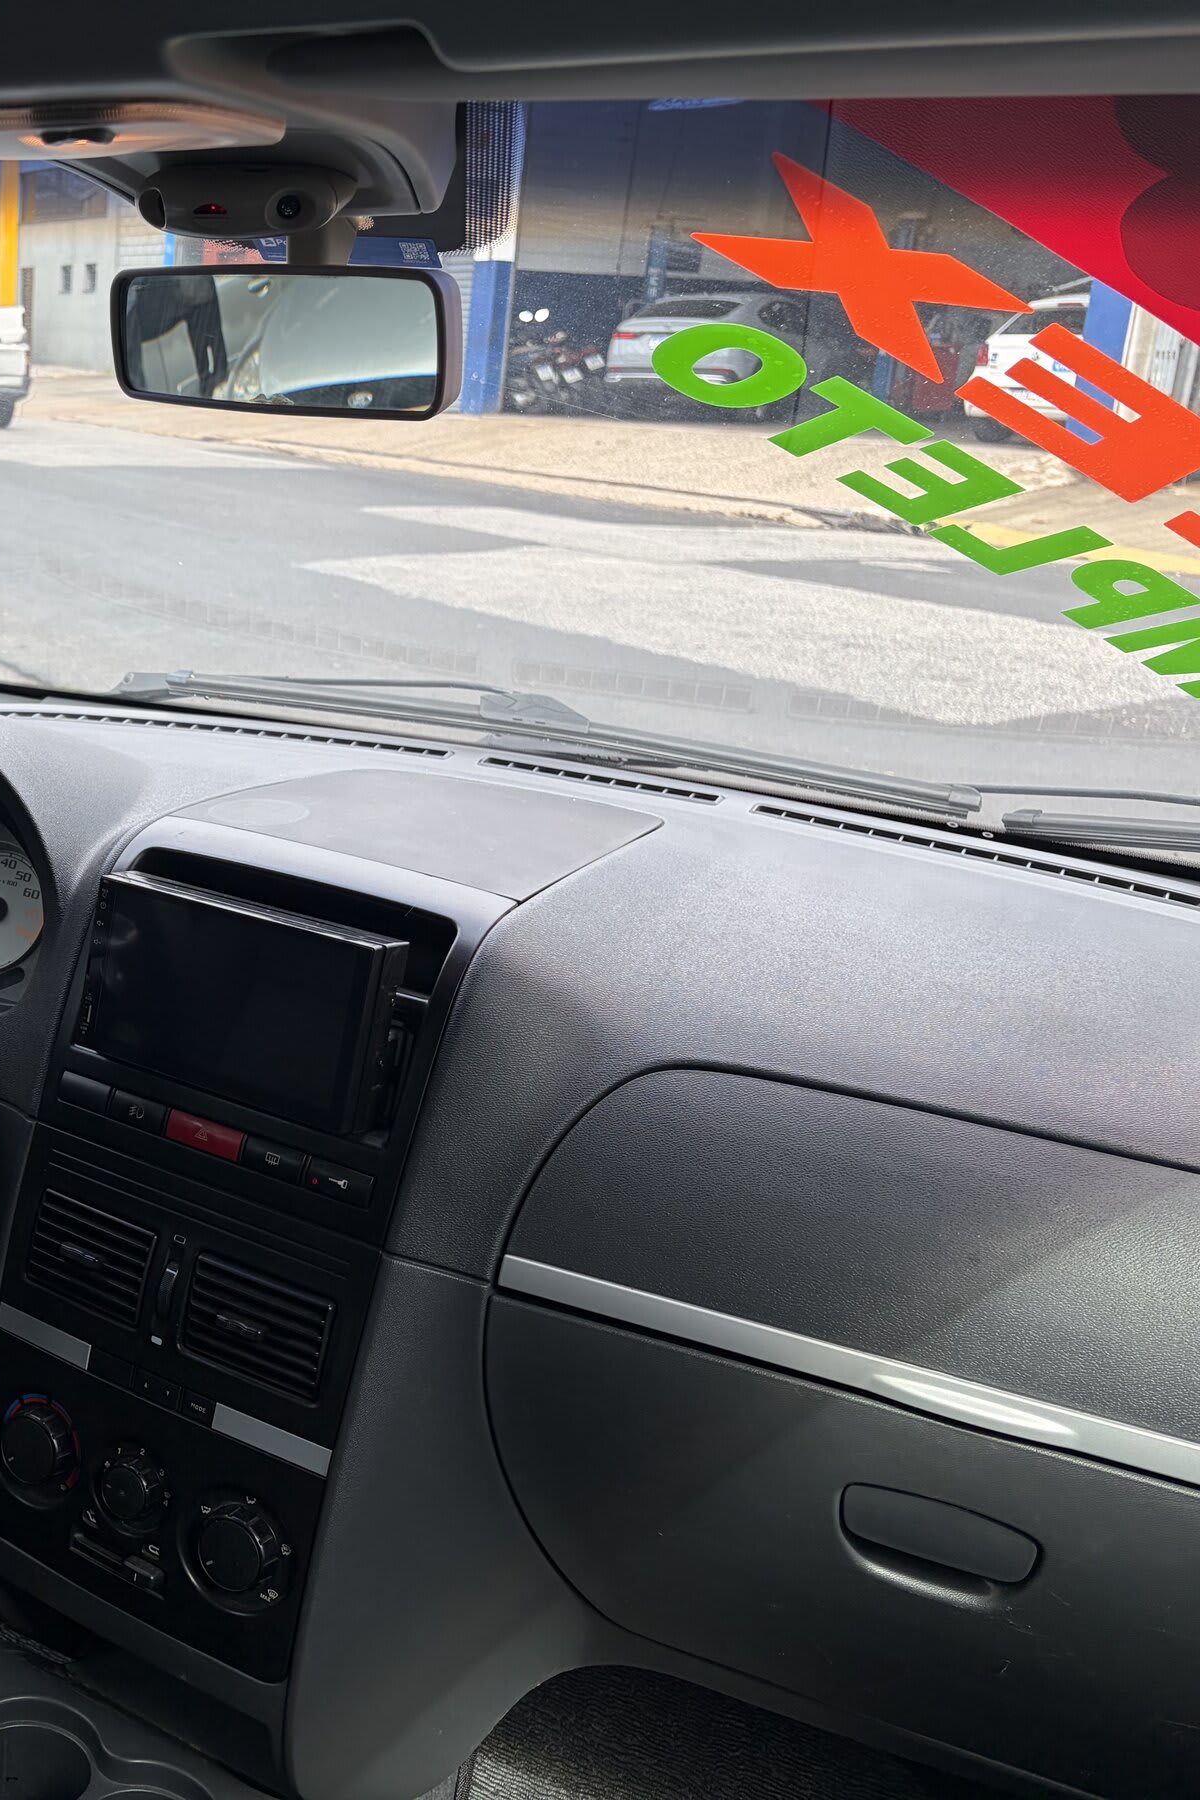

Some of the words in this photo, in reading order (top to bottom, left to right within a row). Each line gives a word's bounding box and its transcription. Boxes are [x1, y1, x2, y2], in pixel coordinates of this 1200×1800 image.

[0, 858, 17, 869] 40
[15, 872, 32, 882] 50
[22, 888, 41, 900] 60
[190, 1402, 208, 1414] MODE
[139, 1447, 146, 1456] 2
